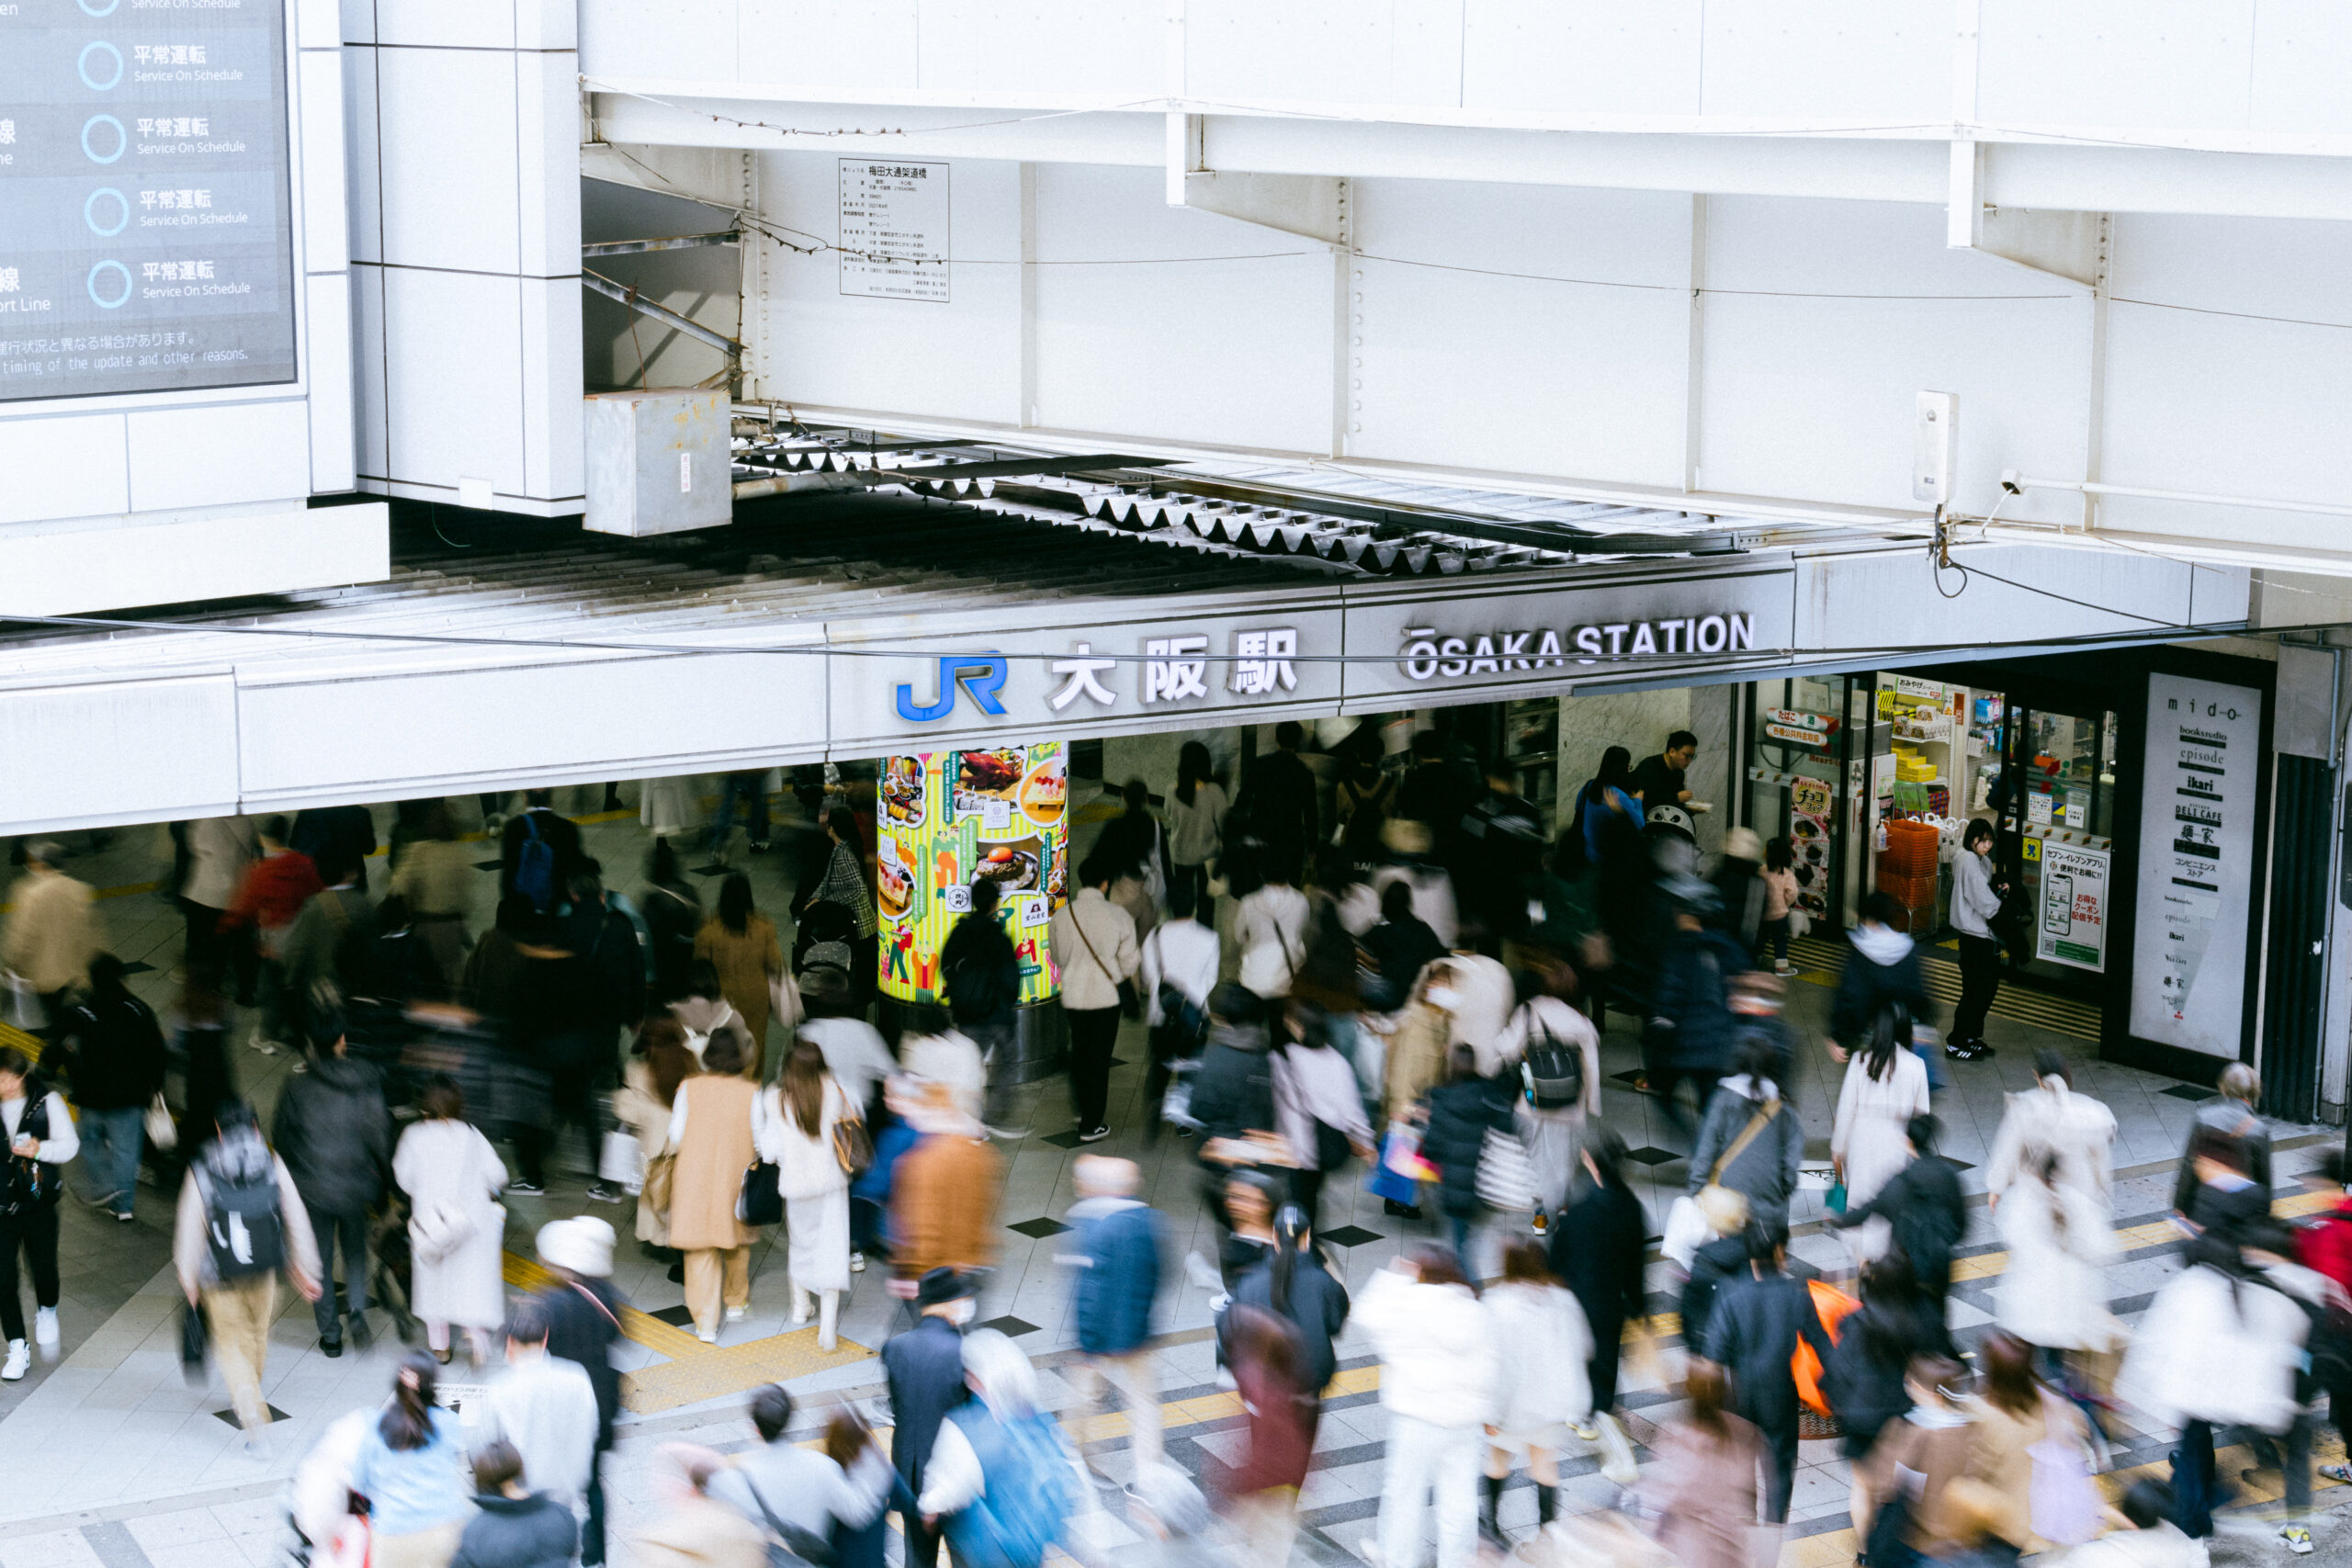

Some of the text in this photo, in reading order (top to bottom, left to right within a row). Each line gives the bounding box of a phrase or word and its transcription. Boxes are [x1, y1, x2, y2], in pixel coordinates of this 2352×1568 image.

[131, 0, 241, 8] Service On Schedule
[134, 45, 207, 65] 平常運転
[134, 69, 243, 82] Service On Schedule
[137, 117, 209, 138] 平常運転
[137, 141, 246, 155] Service On Schedule
[869, 165, 927, 179] 梅田大通架道橋
[140, 189, 212, 210] 平常運転
[140, 212, 248, 227] Service On Schedule
[142, 260, 214, 282] 平常運転
[142, 283, 251, 299] Service On Schedule
[20, 297, 51, 312] Line
[3, 348, 248, 376] timing of the update and other reasons.
[1571, 612, 1757, 665] STATION
[1047, 626, 1298, 712] 大阪駅
[896, 649, 1009, 722] JR
[1899, 679, 1923, 689] おみやげ
[1779, 710, 1796, 722] たばこ
[2179, 725, 2227, 741] bookstudio
[2180, 748, 2224, 764] episode
[2188, 775, 2213, 792] ikari
[1792, 788, 1825, 805] チョコ
[2176, 805, 2222, 821] DELI CAFE
[2176, 858, 2216, 873] コンビニエンス
[2187, 869, 2203, 878] ストア
[2076, 894, 2098, 906] お得な
[2075, 903, 2099, 915] クーポン
[2072, 910, 2101, 926] 配信予定
